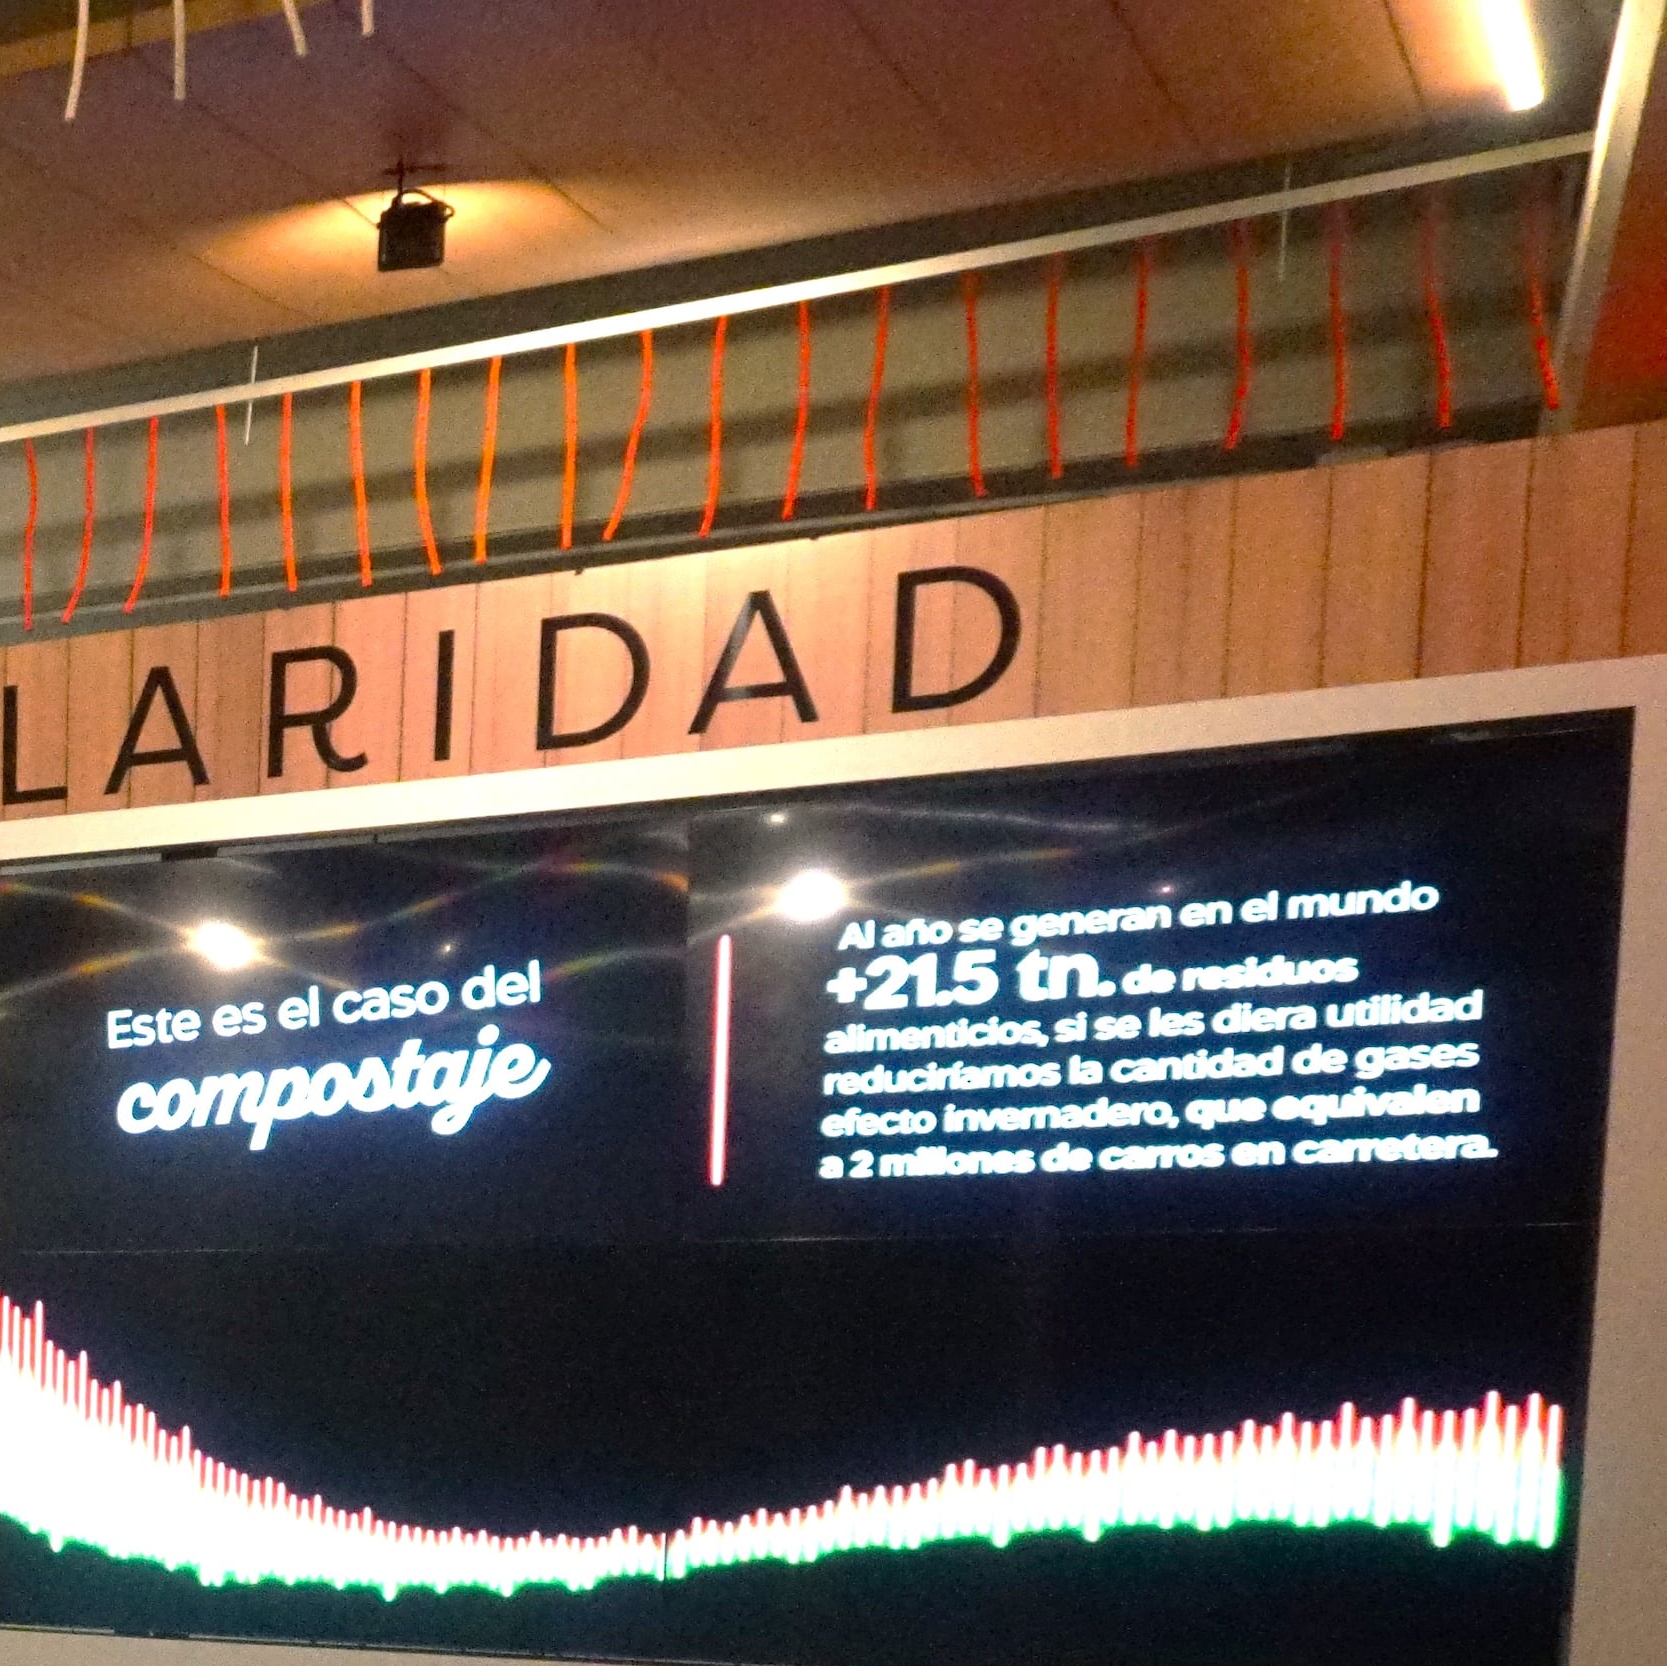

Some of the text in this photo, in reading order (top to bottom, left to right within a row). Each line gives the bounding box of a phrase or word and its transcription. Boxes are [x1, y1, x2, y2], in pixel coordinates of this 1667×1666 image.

[838, 880, 1440, 950] Al año se generan en el mundo
[105, 958, 542, 1050] Este es el caso del
[826, 948, 1361, 1011] +21.5 tn. de residuos
[824, 988, 1484, 1054] alimenticios, si se les diera utilidad
[115, 1022, 552, 1151] compostaje
[823, 1041, 1481, 1096] reduciríamos la cantidad de gases
[820, 1083, 1482, 1138] efecto invernadero, que equivalen
[818, 1133, 1500, 1180] a 2 millones de carros en carretera.
